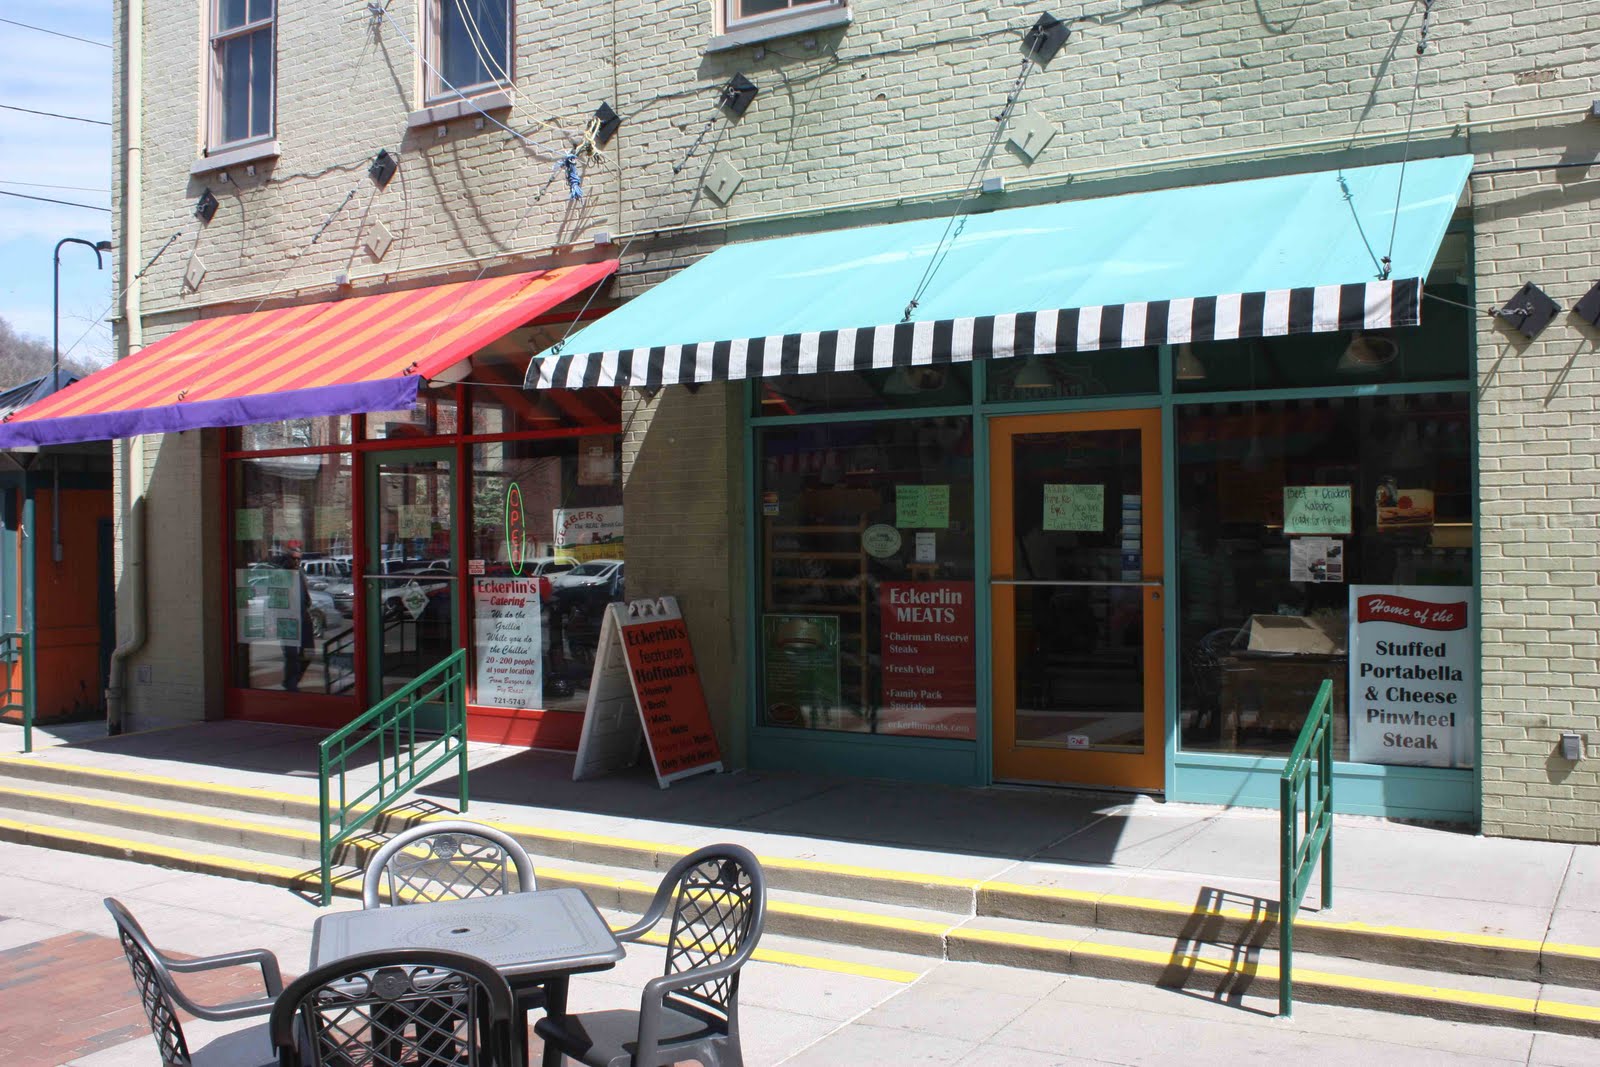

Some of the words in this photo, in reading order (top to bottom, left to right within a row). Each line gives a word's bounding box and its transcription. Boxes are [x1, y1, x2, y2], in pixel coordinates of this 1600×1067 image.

[477, 580, 537, 594] Eckerlin's
[490, 596, 526, 606] Catering
[890, 588, 962, 605] Eckerlin
[491, 610, 503, 619] We
[505, 611, 513, 619] do
[513, 611, 526, 619] the
[897, 607, 956, 623] MEATS
[1367, 598, 1411, 617] Home
[1413, 607, 1429, 623] of
[1432, 607, 1454, 623] the
[495, 622, 523, 631] Grillin'
[486, 633, 507, 643] While
[508, 636, 522, 645] you
[523, 634, 533, 643] do
[627, 625, 687, 647] Eckerlin's
[889, 632, 932, 642] Chairman
[933, 632, 969, 643] Reserve
[490, 645, 500, 654] the
[639, 646, 684, 664] features
[889, 644, 918, 654] Steaks
[1375, 640, 1446, 658] Stuffed
[485, 657, 495, 665] 20
[499, 657, 513, 665] 200
[513, 658, 536, 667] people
[493, 667, 508, 676] your
[508, 666, 535, 675] location
[636, 663, 696, 684] Hoffman's
[889, 664, 914, 674] Fresh
[916, 665, 935, 675] Veal
[1360, 662, 1463, 682] Portabella
[488, 676, 503, 684] From
[503, 677, 524, 687] Burgers
[890, 689, 917, 700] Family
[920, 690, 942, 700] Pack
[1365, 686, 1379, 701] &
[1385, 686, 1458, 705] Cheese
[889, 701, 926, 712] Specials
[1366, 708, 1456, 728] Pinwheel
[1383, 732, 1438, 750] Steak
